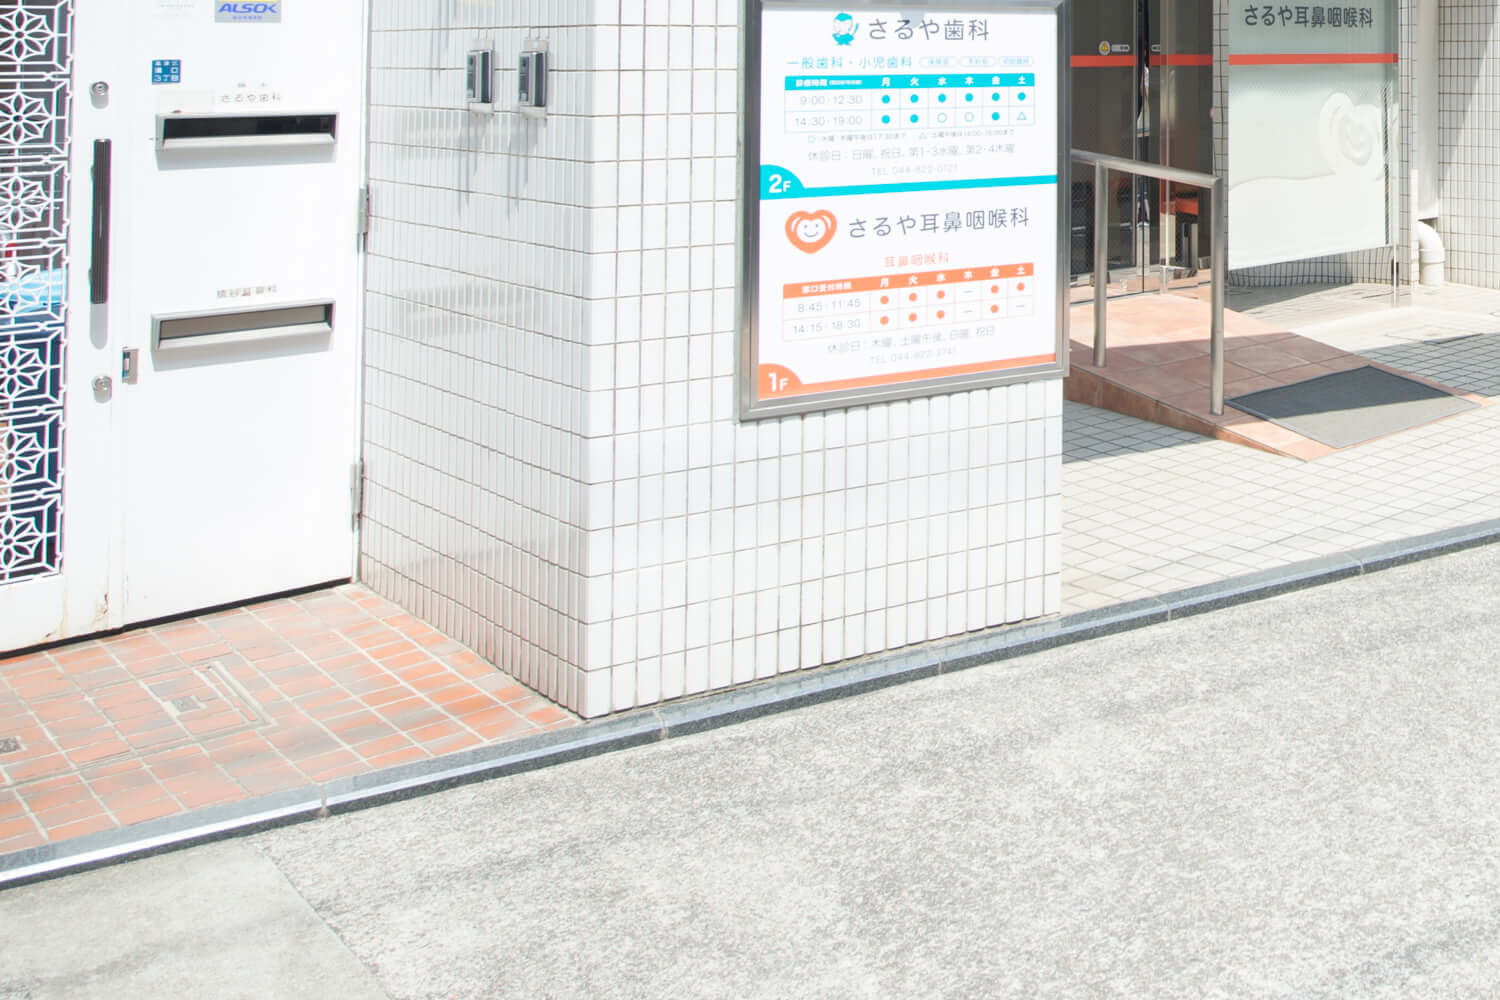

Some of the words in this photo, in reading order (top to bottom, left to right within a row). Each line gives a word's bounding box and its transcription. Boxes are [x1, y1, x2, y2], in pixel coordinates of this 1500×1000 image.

[219, 3, 278, 13] ALSOK
[1244, 4, 1374, 29] さるや耳鼻咽喉科
[868, 18, 989, 42] さるや歯科
[881, 77, 891, 88] 月
[909, 76, 920, 87] 火
[1017, 74, 1027, 85] 土
[769, 174, 791, 193] 2F
[848, 207, 1029, 239] さるや耳鼻咽喉科
[884, 252, 950, 268] 耳鼻咽喉科
[880, 277, 889, 288] 月
[908, 275, 918, 286] 火
[1016, 265, 1026, 275] 土
[768, 373, 789, 392] 1F
